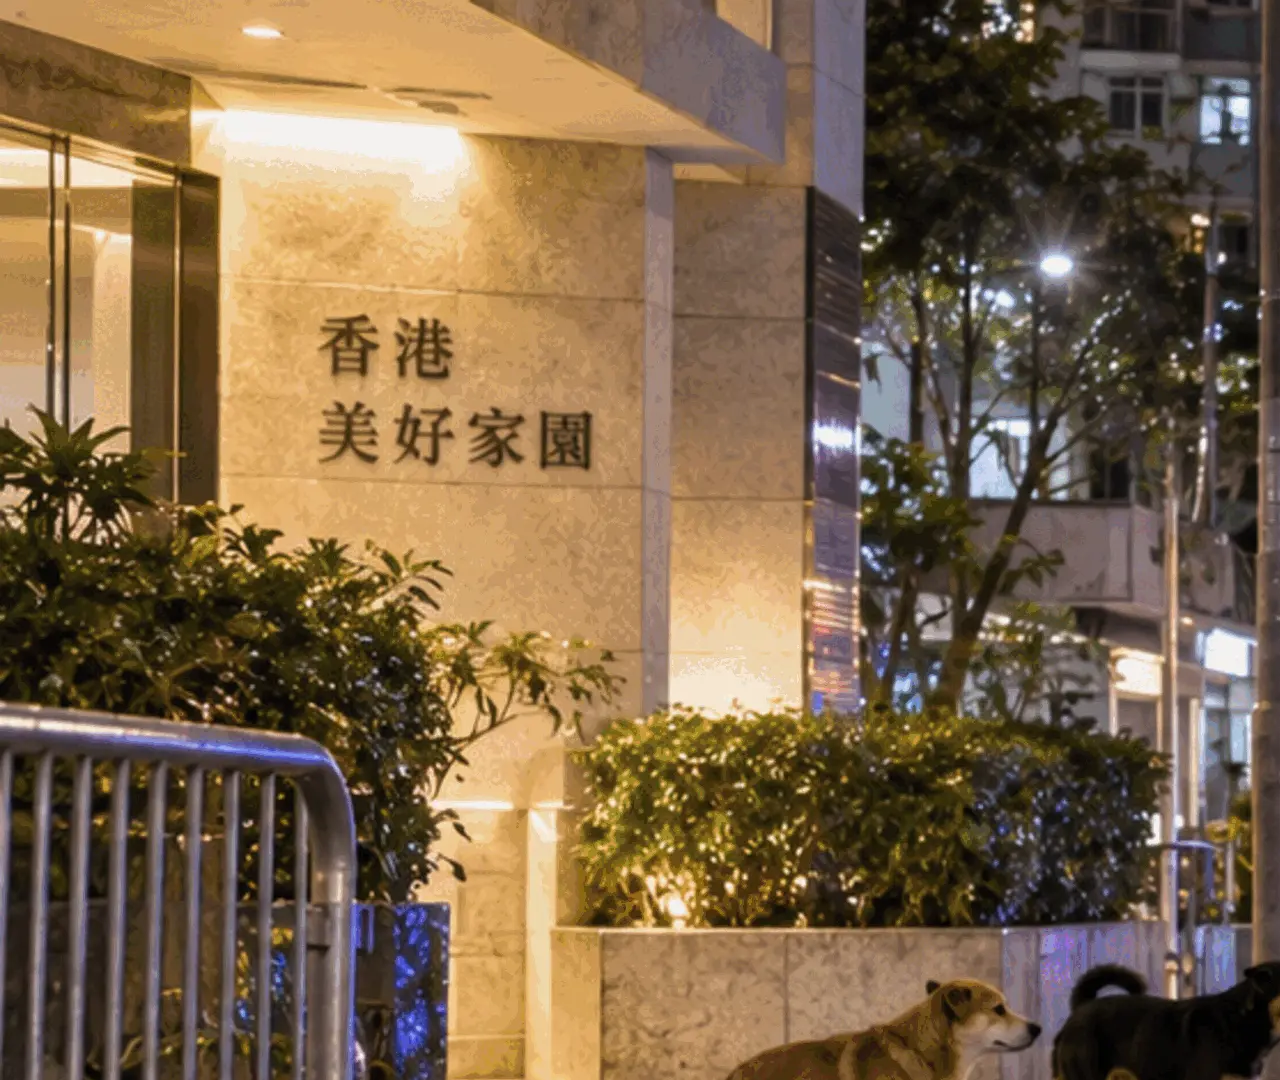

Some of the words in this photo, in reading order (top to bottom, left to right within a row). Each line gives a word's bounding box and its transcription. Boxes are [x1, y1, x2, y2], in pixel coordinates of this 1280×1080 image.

[319, 314, 453, 379] 香港
[318, 400, 593, 470] 美好家園
